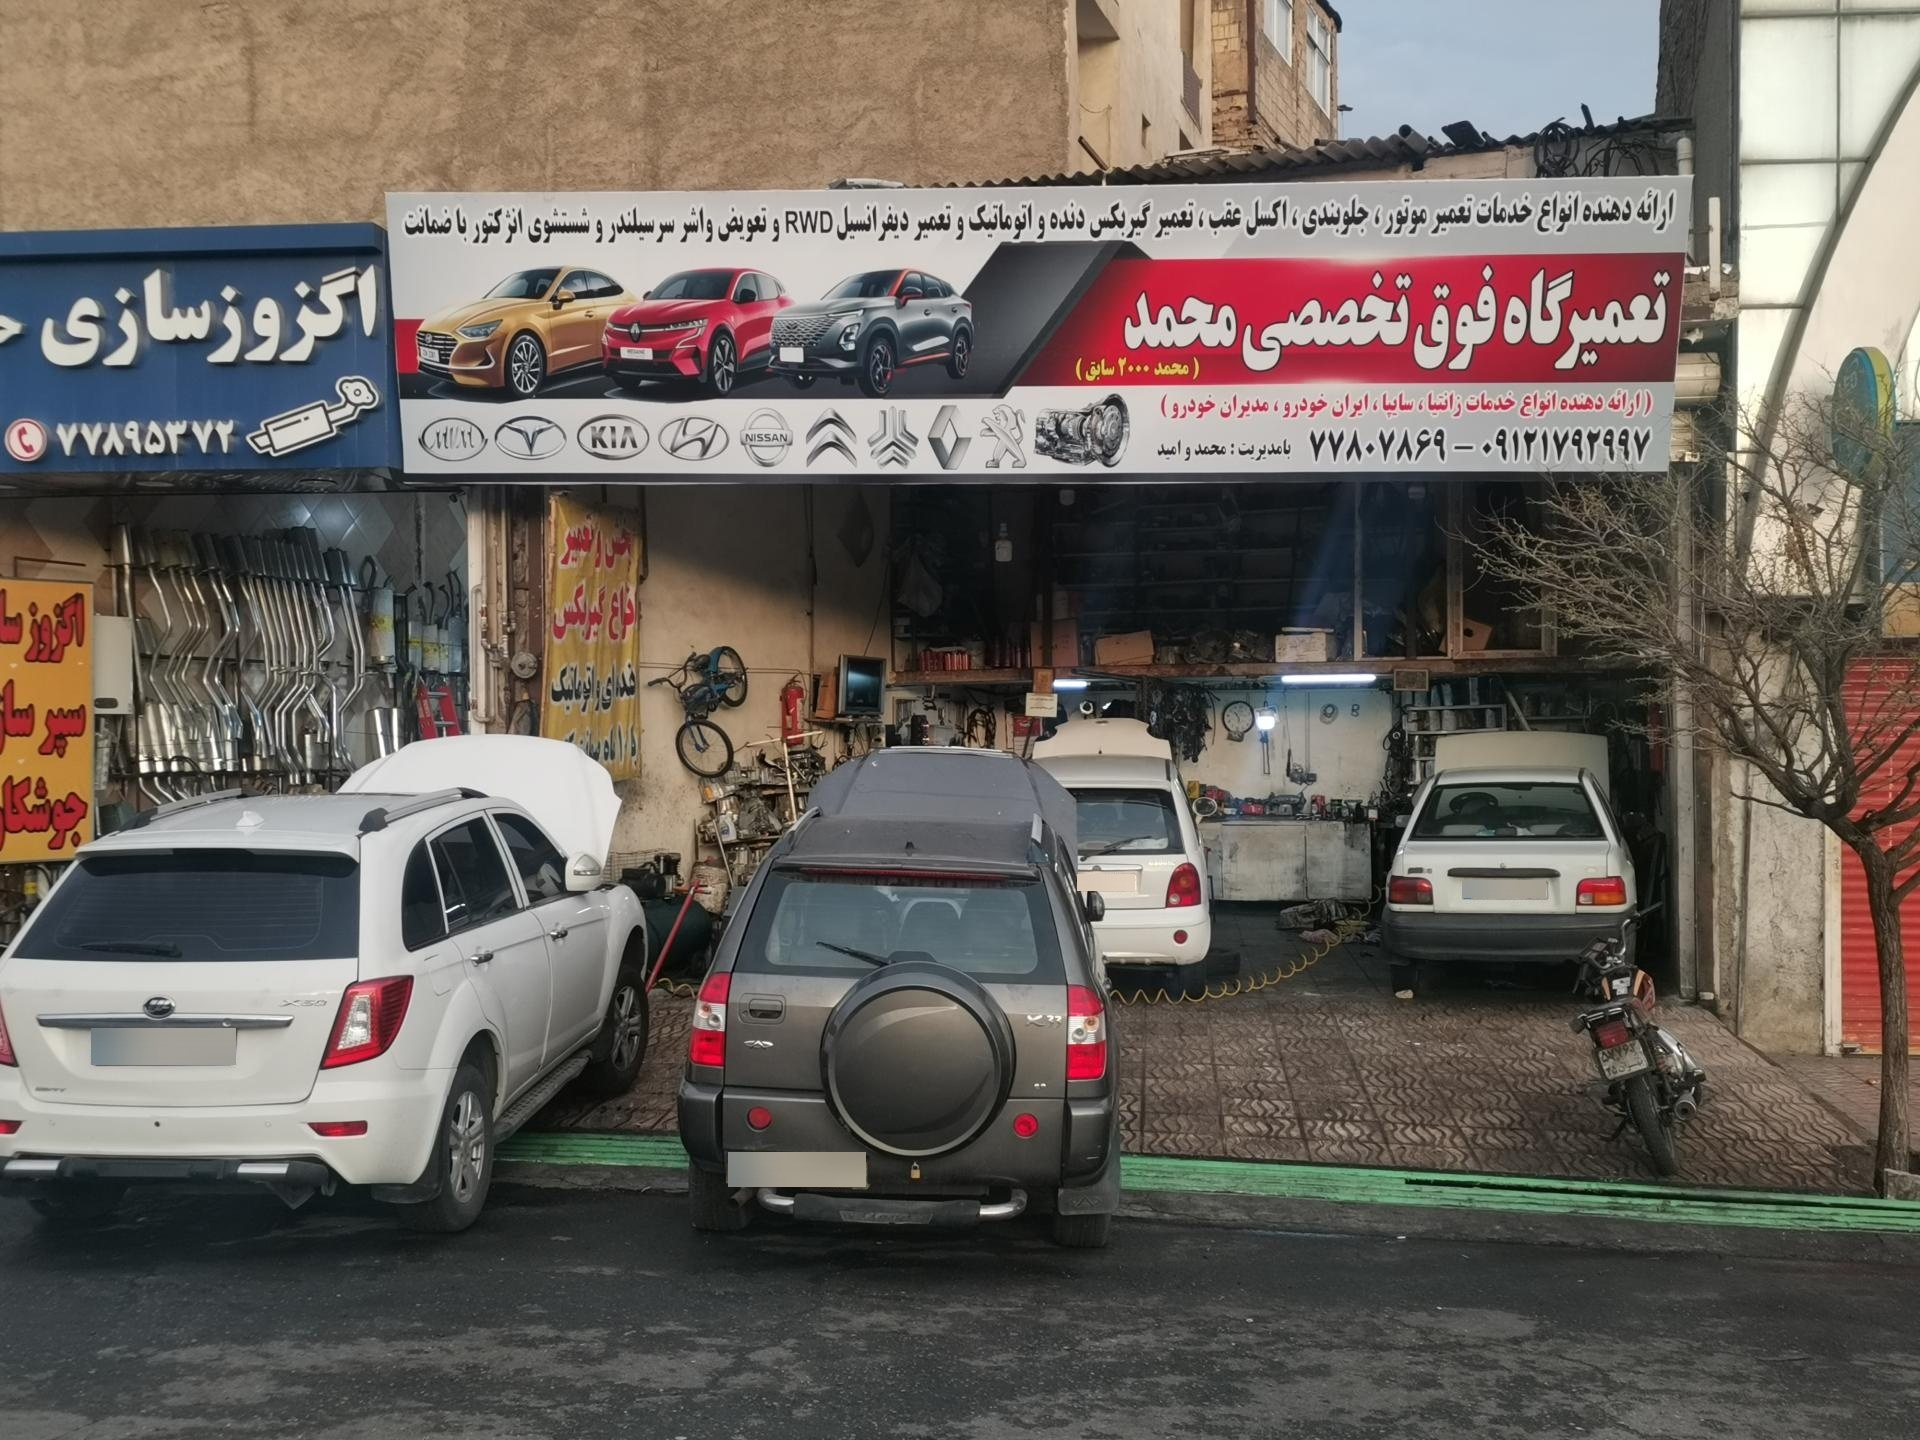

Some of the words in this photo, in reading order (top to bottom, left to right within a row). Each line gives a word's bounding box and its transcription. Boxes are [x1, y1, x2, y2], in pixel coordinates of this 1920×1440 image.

[405, 208, 452, 235] ضمانت
[456, 208, 467, 242] با
[528, 208, 590, 243] شستشوی
[680, 206, 713, 243] واشر
[718, 207, 767, 242] تعویض
[785, 210, 833, 234] RWD
[914, 205, 951, 241] تعمیر
[968, 204, 1032, 240] اتوماتیک
[1050, 202, 1085, 230] دنده
[1090, 201, 1151, 239] گیربکس
[1155, 201, 1193, 238] تعمیر
[1246, 199, 1287, 236] اکسل
[1431, 198, 1473, 234] تعمیر
[1476, 195, 1532, 224] خدمات
[1537, 193, 1579, 232] انواع
[1583, 197, 1631, 222] دهنده
[1637, 190, 1674, 231] ارائه
[595, 219, 602, 243] و
[772, 218, 780, 242] و
[956, 216, 964, 240] و
[1037, 215, 1045, 239] و
[1124, 291, 1237, 350] محمد
[1242, 271, 1413, 372] تخصصی
[1413, 264, 1497, 371] فوق
[1503, 267, 1671, 370] تعمیرگاه
[1118, 356, 1150, 376] ۲۰۰۰
[1220, 393, 1269, 418] مدیران
[1332, 393, 1369, 417] ایران
[1466, 392, 1515, 411] خدمات
[1520, 392, 1556, 417] انواع
[1560, 394, 1603, 411] دهنده
[56, 419, 235, 456] ۷۷۸۹۵۳۷۲
[591, 426, 638, 449] KIA
[745, 433, 788, 442] NISSAN
[1157, 439, 1182, 460] امید
[1185, 447, 1191, 461] و
[1194, 441, 1227, 456] محمد
[1309, 429, 1446, 462] ۷۷۸۰۷۸۶۹
[1482, 428, 1651, 462] ۰۹۱۲۱۷۹۲۹۹۷
[24, 592, 85, 663] اگزوز
[38, 703, 86, 759] سپر
